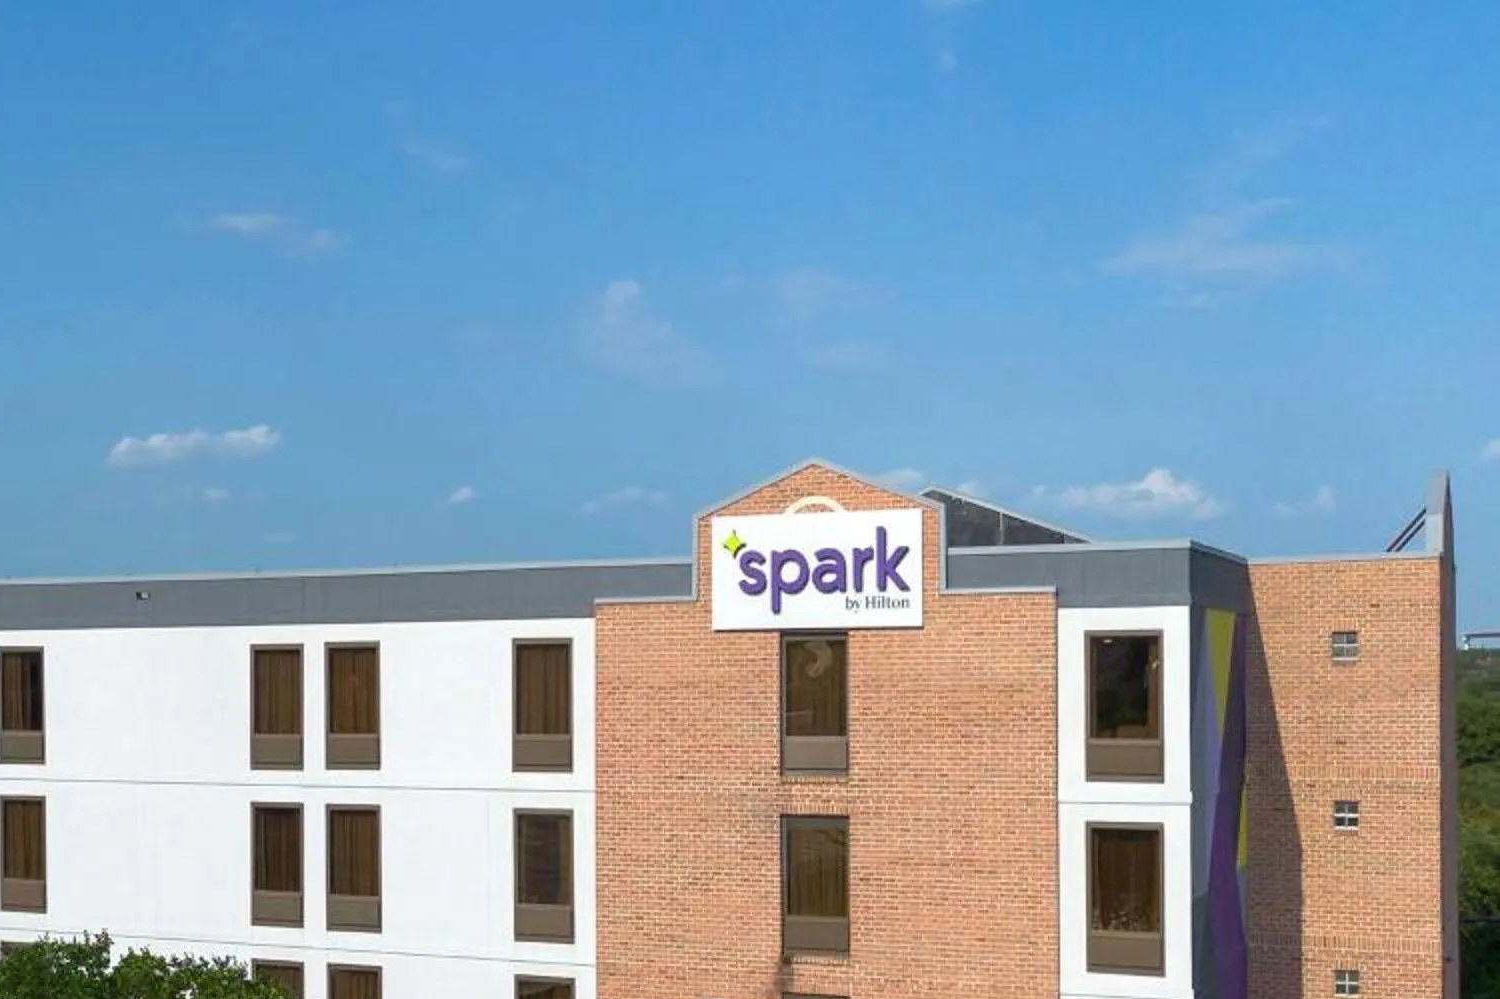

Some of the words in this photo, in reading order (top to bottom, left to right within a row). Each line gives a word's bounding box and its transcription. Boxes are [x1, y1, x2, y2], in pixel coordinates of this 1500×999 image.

[738, 526, 911, 615] spark
[845, 595, 860, 614] by
[865, 595, 910, 609] Hilton
